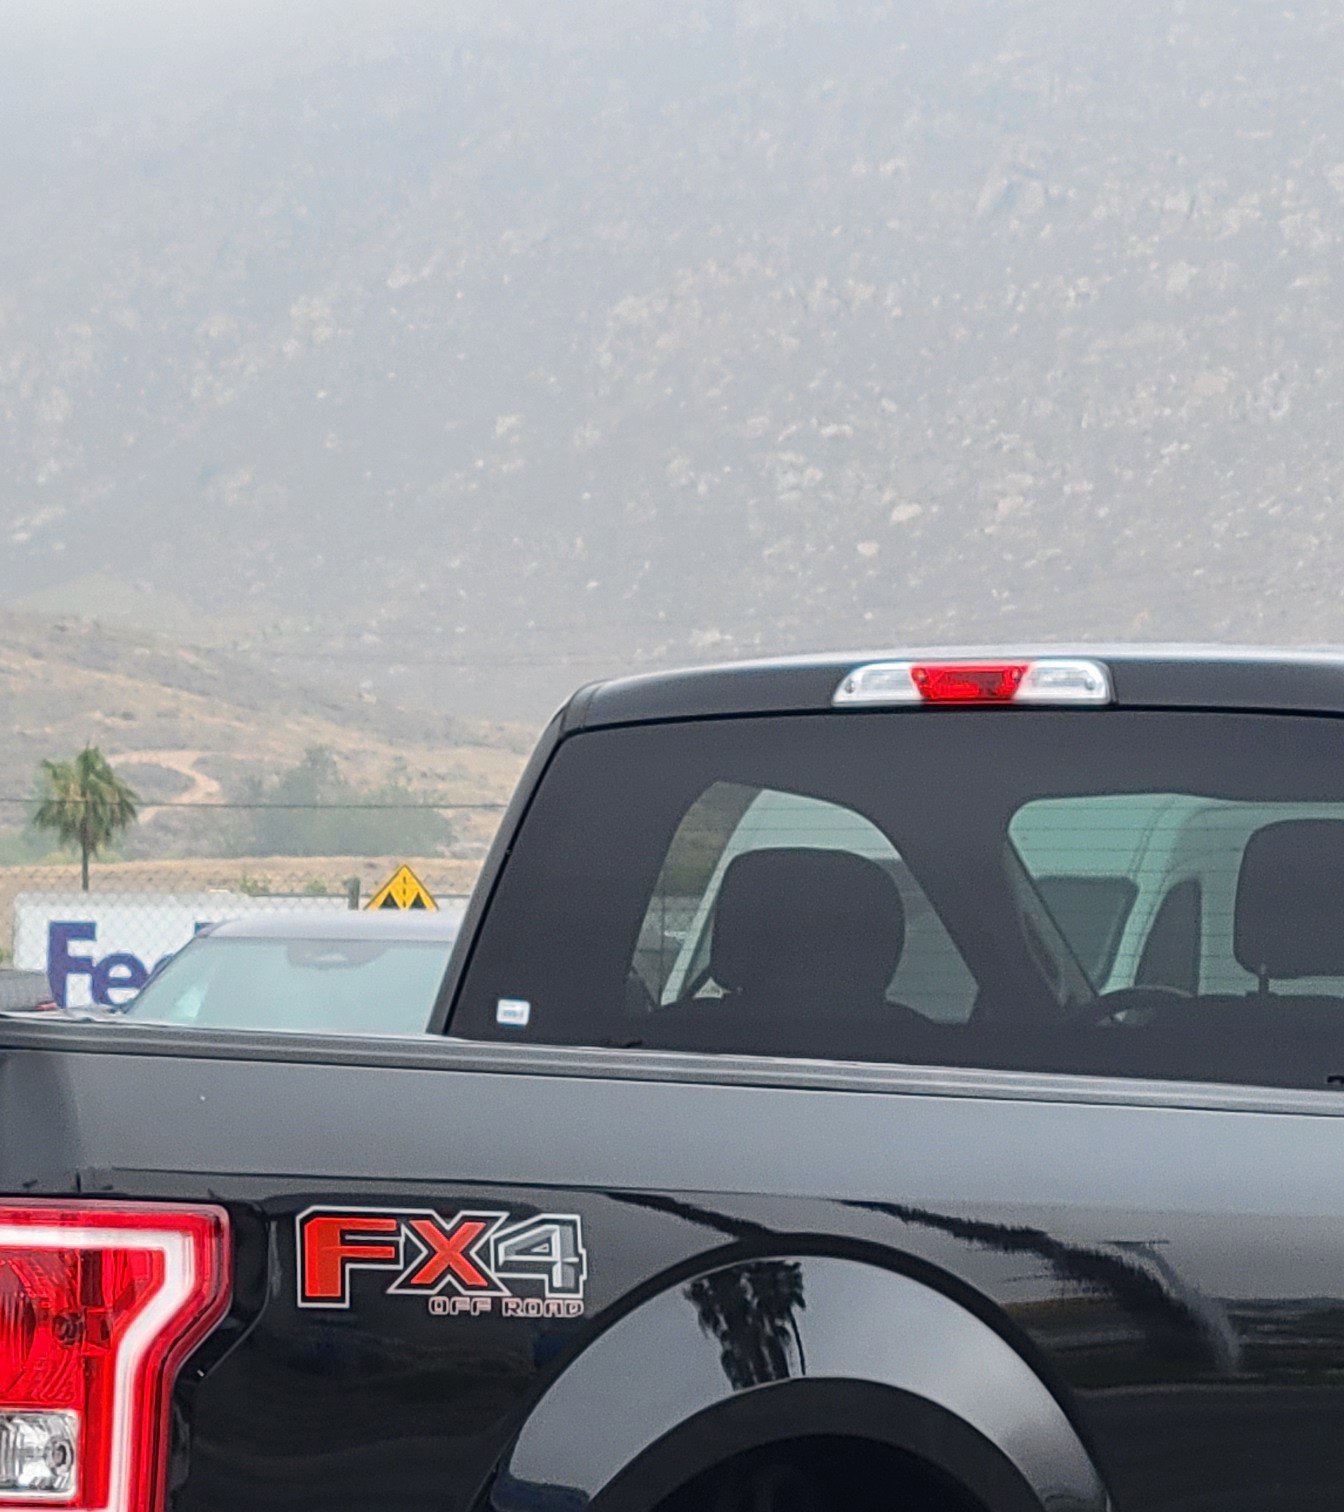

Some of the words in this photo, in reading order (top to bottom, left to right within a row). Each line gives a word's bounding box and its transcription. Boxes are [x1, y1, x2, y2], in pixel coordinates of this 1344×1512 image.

[296, 1205, 587, 1308] FX4
[429, 1296, 492, 1316] OFF
[502, 1298, 585, 1318] ROAD
